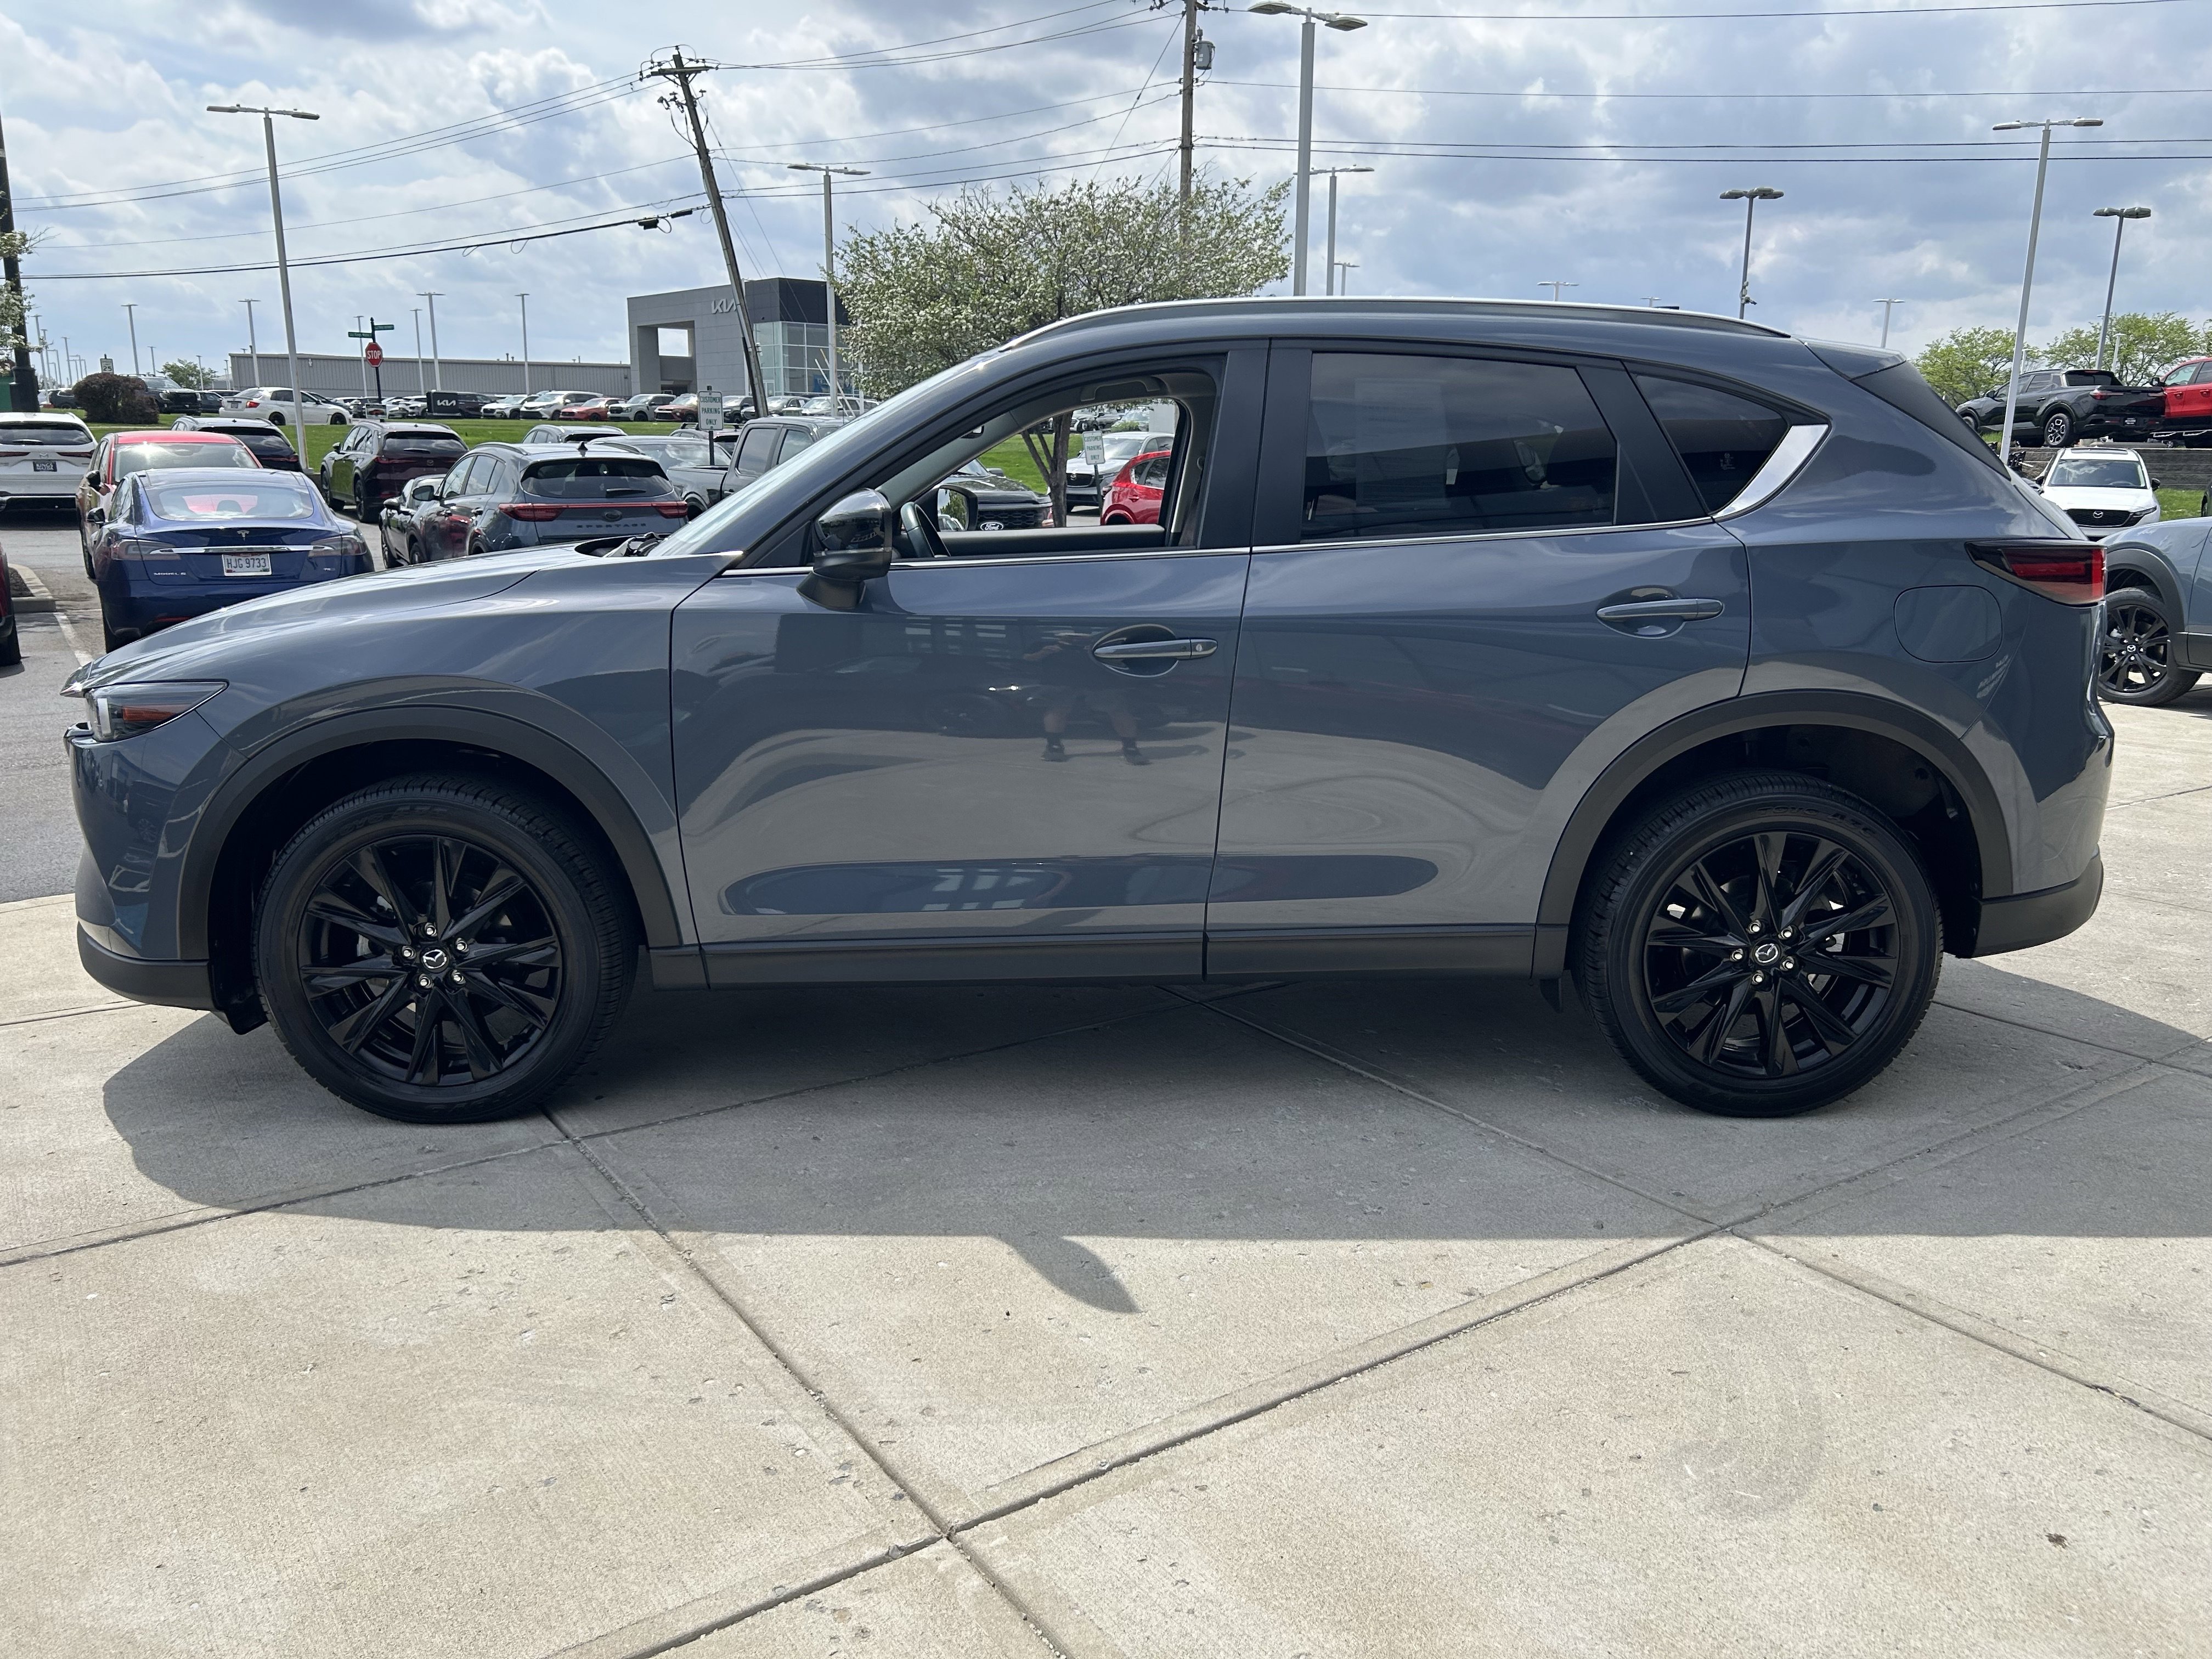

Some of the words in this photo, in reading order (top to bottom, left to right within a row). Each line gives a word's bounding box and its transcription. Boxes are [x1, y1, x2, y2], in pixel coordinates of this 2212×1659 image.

[711, 298, 736, 314] KIA
[367, 350, 381, 359] STOP
[226, 558, 243, 568] HJG
[245, 557, 267, 568] 9733
[1757, 805, 1819, 816] TOYO
